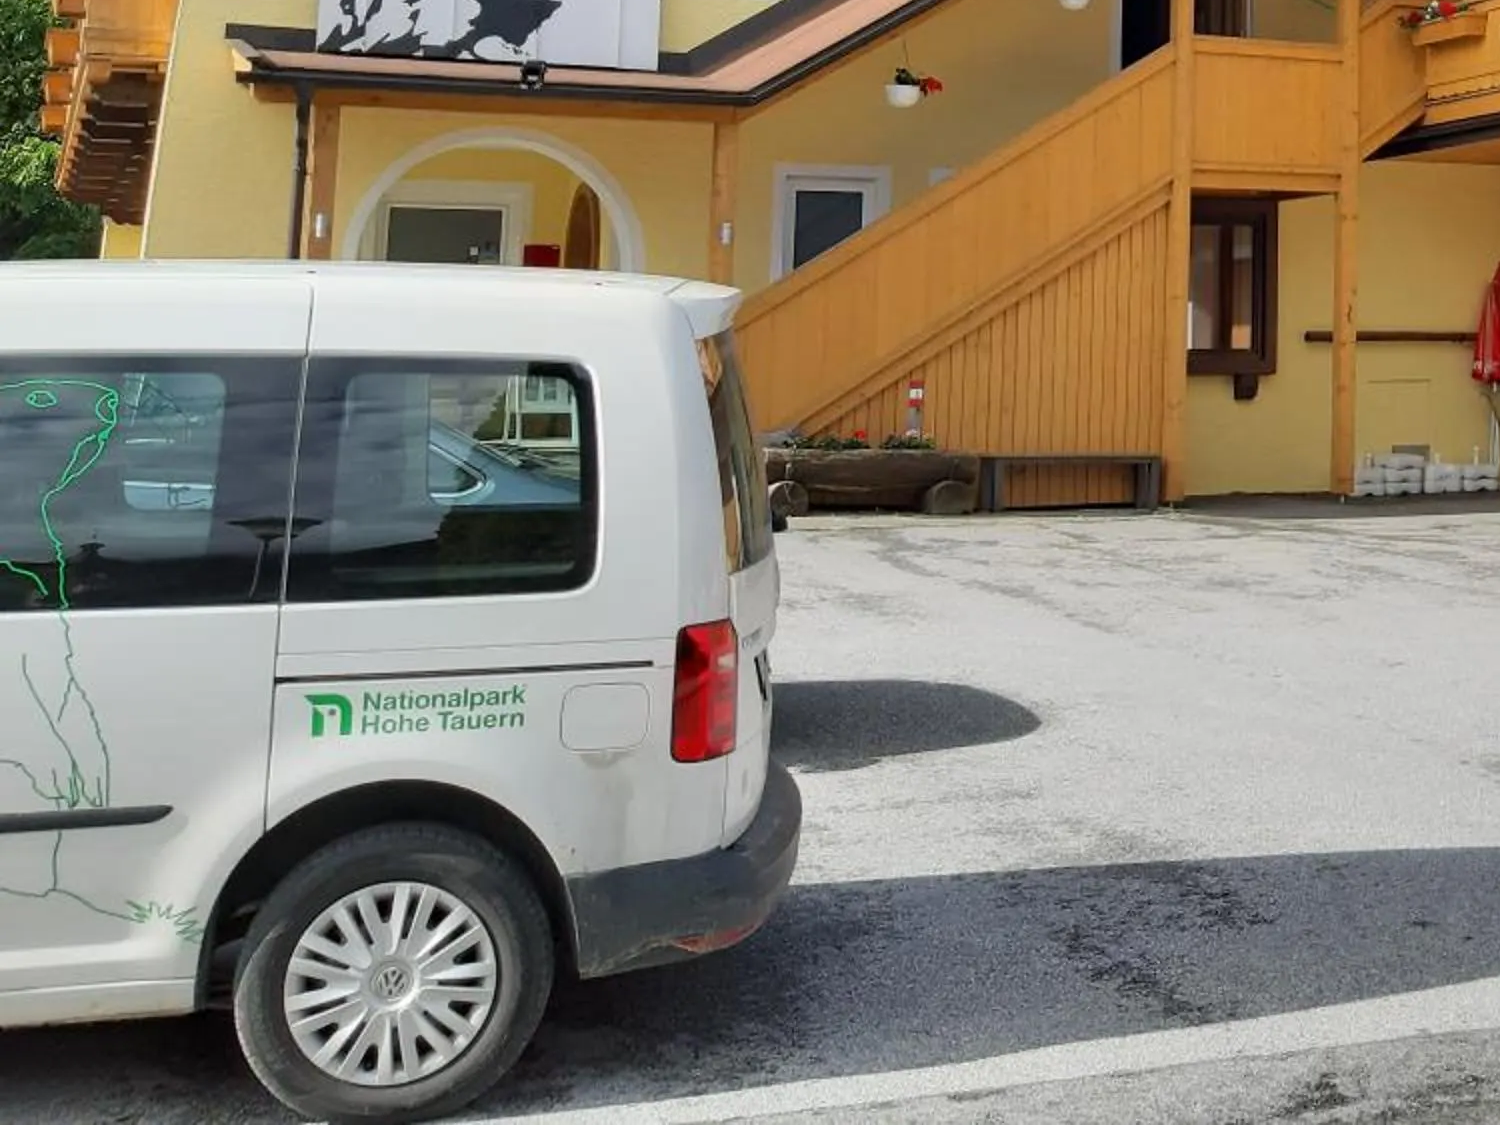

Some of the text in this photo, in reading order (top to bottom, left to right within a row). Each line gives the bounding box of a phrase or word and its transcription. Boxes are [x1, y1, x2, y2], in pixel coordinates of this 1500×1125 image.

[362, 684, 526, 711] Nationalpark
[361, 711, 524, 735] Hohe Tauern
